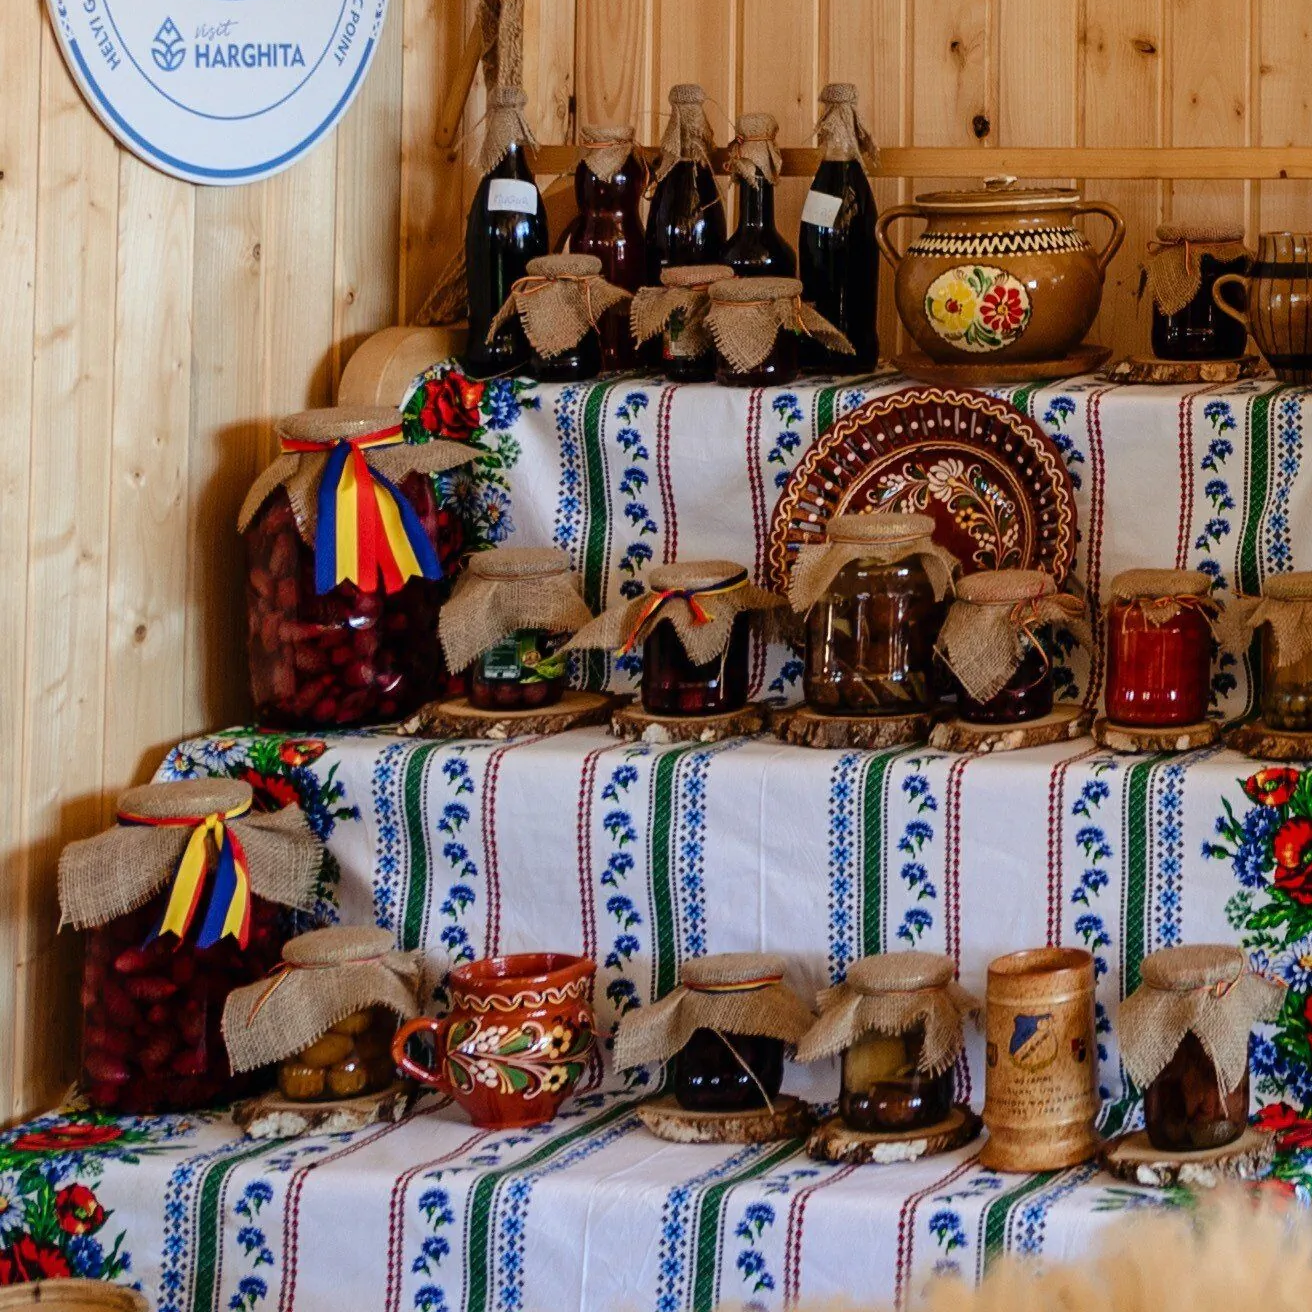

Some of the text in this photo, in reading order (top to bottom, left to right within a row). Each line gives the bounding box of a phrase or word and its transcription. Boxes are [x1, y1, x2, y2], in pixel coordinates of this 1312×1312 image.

[89, 15, 121, 71] HELYI
[195, 43, 306, 68] HARGHITA
[334, 9, 360, 67] POINT
